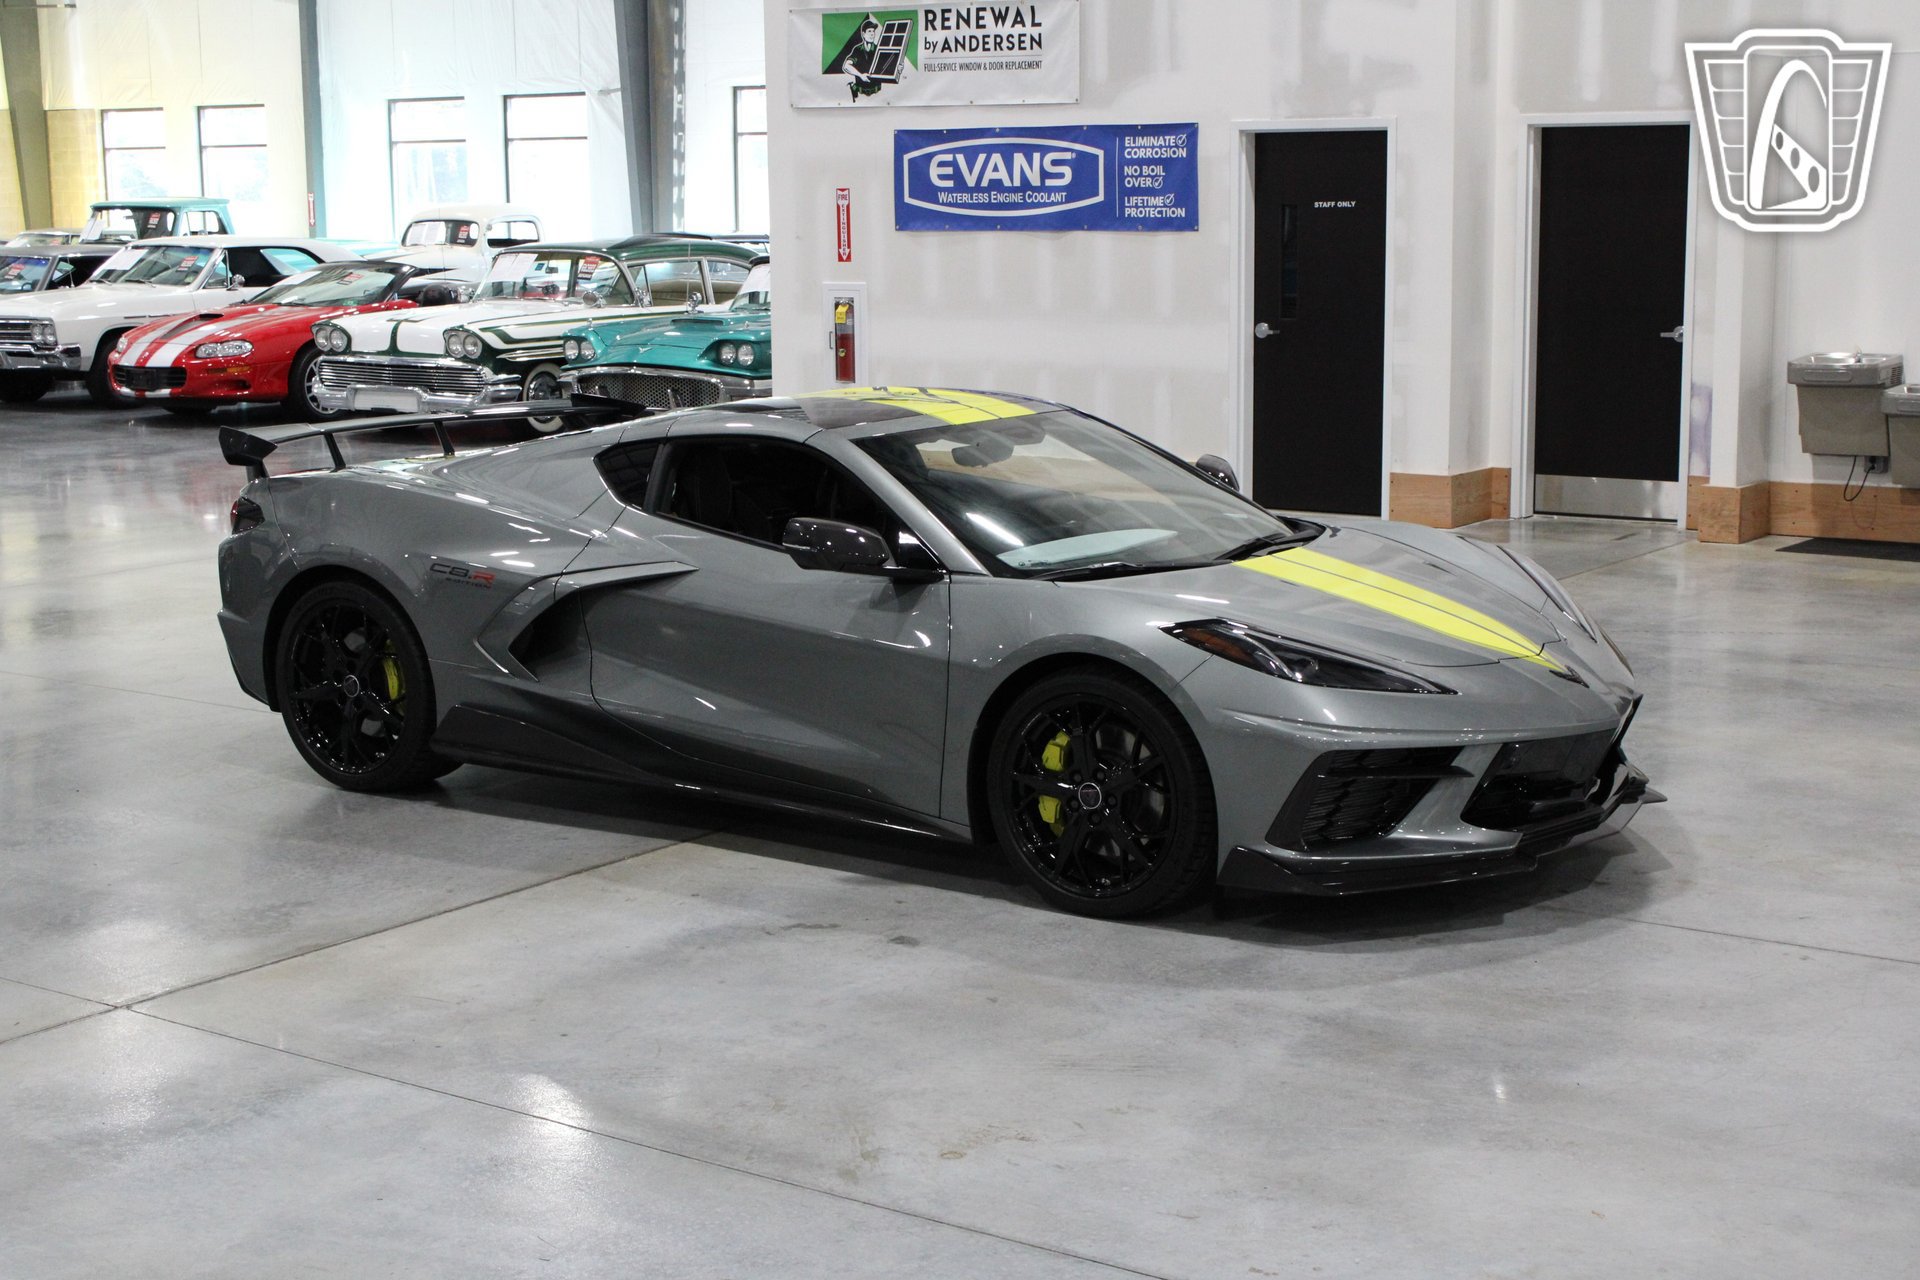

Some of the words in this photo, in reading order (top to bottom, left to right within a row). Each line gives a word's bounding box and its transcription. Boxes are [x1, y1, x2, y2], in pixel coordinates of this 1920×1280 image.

[924, 5, 1042, 31] RENEWAL
[924, 36, 938, 53] by
[940, 33, 1042, 53] ANDERSEN
[924, 62, 957, 72] FULL-SERVICE
[959, 62, 982, 71] WINDOW
[983, 62, 987, 71] &
[989, 61, 1004, 71] DOOR
[1005, 60, 1042, 70] REPLACEMENT
[1124, 136, 1176, 147] ELIMINATE
[1124, 147, 1187, 159] CORROSION
[1124, 165, 1140, 176] NO
[1142, 165, 1166, 176] BOIL
[1124, 177, 1153, 188] OVER
[1124, 196, 1164, 207] LIFETIME
[1337, 200, 1356, 208] ONLY
[1124, 207, 1186, 218] PROTECTION
